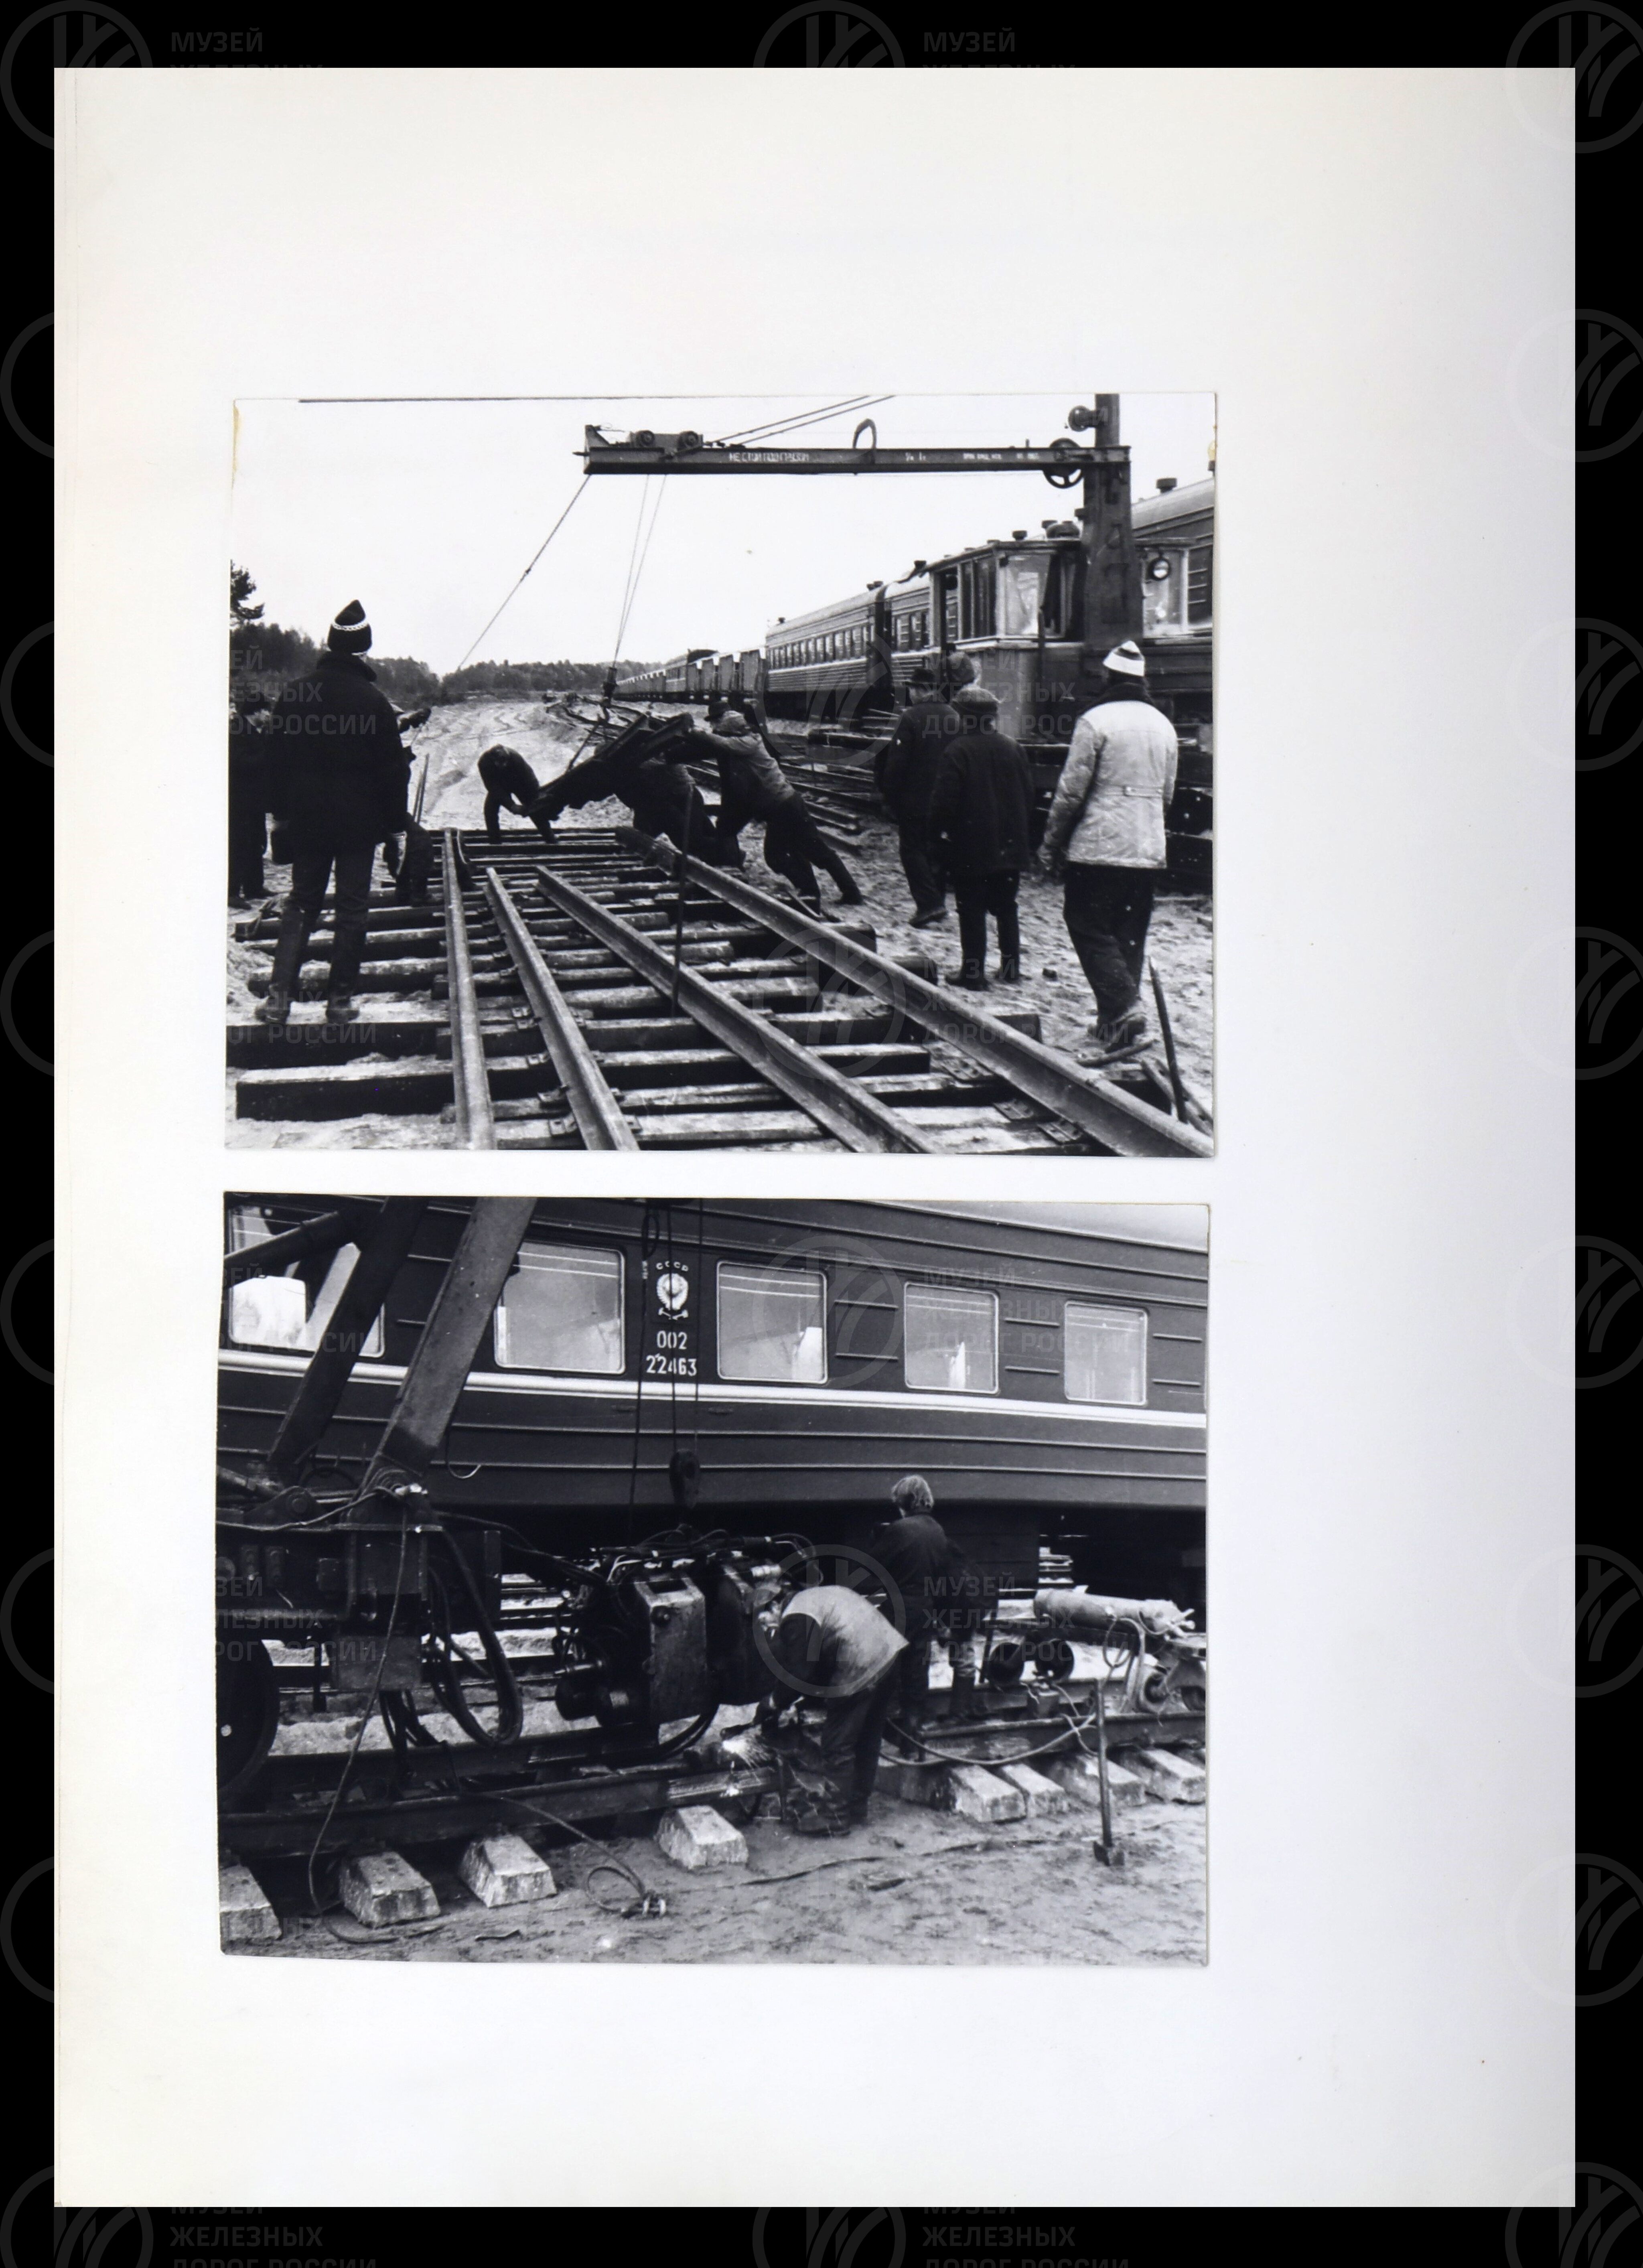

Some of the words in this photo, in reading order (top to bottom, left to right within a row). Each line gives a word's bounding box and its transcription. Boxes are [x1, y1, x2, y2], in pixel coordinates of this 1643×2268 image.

[655, 1260, 689, 1272] СССР
[656, 1330, 688, 1350] 002
[646, 1354, 698, 1377] 22463
